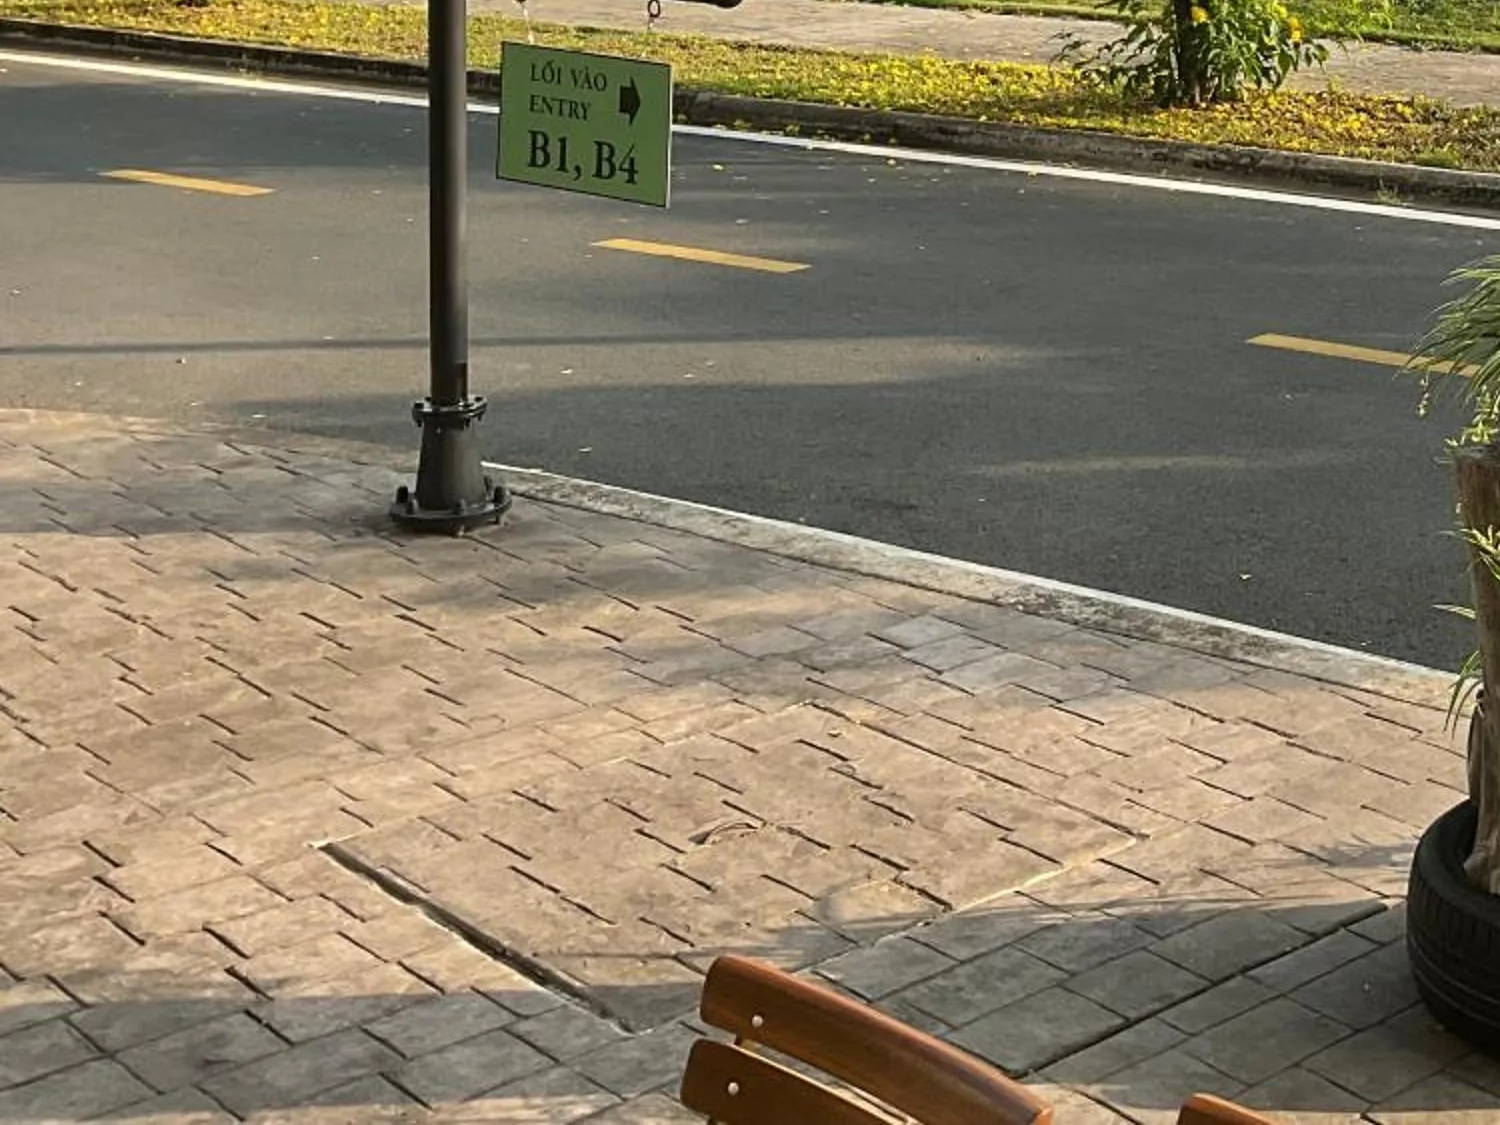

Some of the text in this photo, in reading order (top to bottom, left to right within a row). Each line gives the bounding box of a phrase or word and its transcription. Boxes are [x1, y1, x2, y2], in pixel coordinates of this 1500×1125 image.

[530, 59, 608, 92] LỐI VÀO
[529, 94, 592, 121] ENTRY
[527, 129, 639, 185] B1, B4
